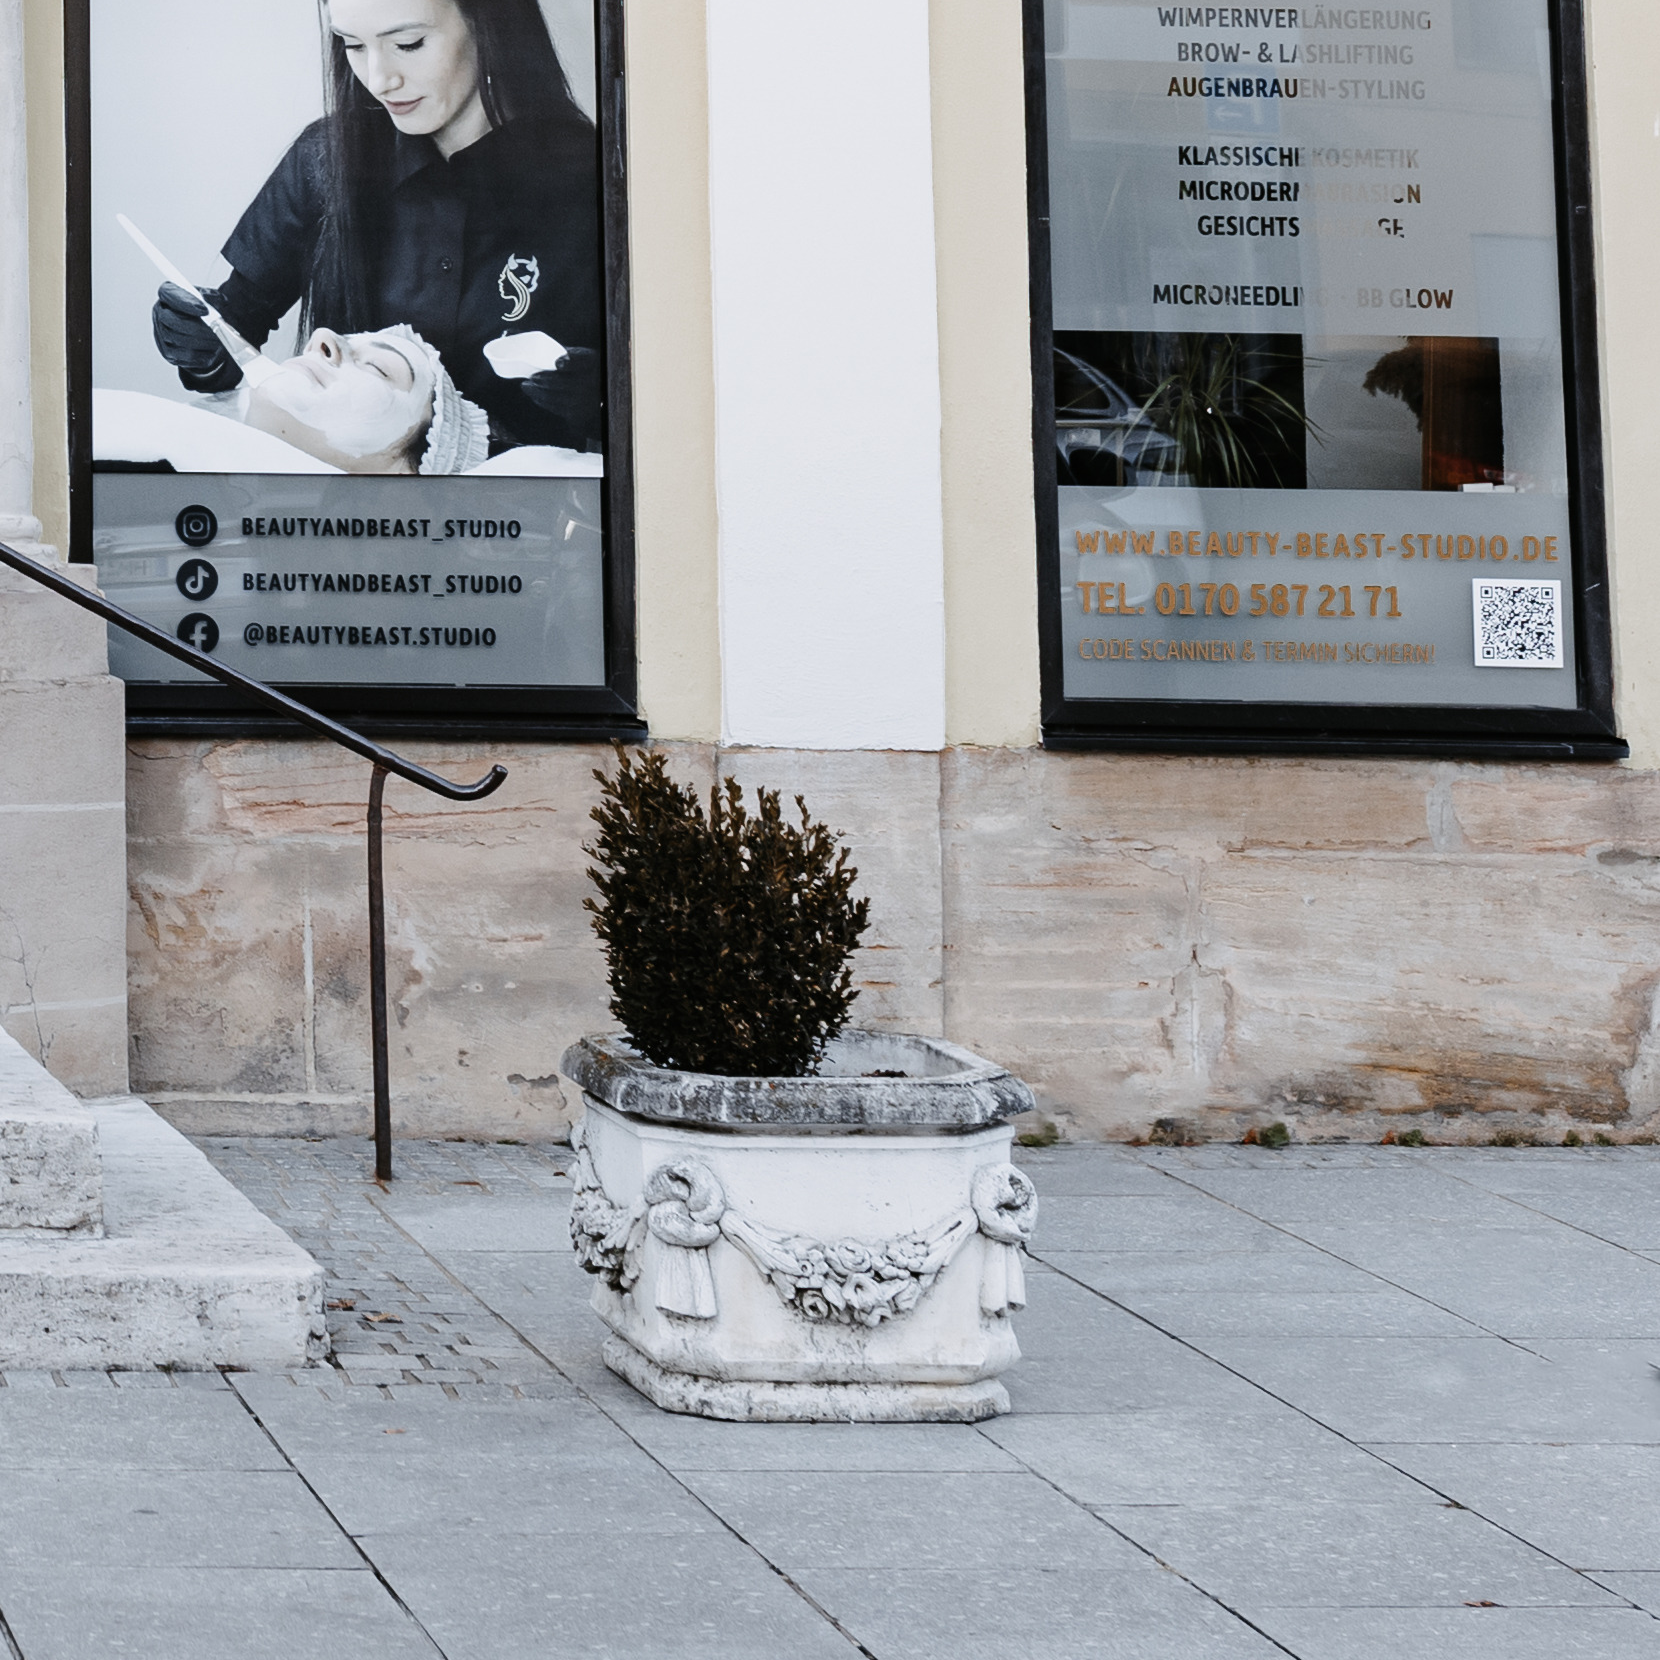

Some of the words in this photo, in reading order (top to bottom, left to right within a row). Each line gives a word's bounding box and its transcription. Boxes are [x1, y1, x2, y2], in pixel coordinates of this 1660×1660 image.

[1157, 5, 1432, 31] WIMPERNVERLÄNGERUNG
[1177, 42, 1251, 63] BROW-
[1257, 43, 1273, 64] &
[1279, 44, 1414, 66] LASHLIFTING
[1167, 76, 1427, 101] AUGENBRAUEN-STYLING
[1178, 146, 1306, 168] KLASSISCHE
[1312, 148, 1420, 169] KOSMETIK
[1389, 289, 1454, 310] GLOW
[241, 517, 522, 542] BEAUTYANDBEAST_STUDIO
[1075, 530, 1559, 562] WWW.BEAUTY-BEAST-STUDIO.DE
[242, 572, 523, 597] BEAUTYANDBEAST_STUDIO
[1077, 581, 1146, 615] TEL.
[1155, 582, 1240, 617] 0170
[1249, 583, 1309, 618] 587
[1318, 584, 1355, 618] 21
[1364, 585, 1403, 618] 71
[243, 622, 498, 647] @BEAUTYBEAST.STUDIO
[1080, 638, 1136, 660] CODE
[1141, 639, 1236, 662] SCANNEN
[1241, 640, 1256, 662] &
[1262, 641, 1338, 663] TERMIN
[1344, 642, 1436, 664] SICHERN!
